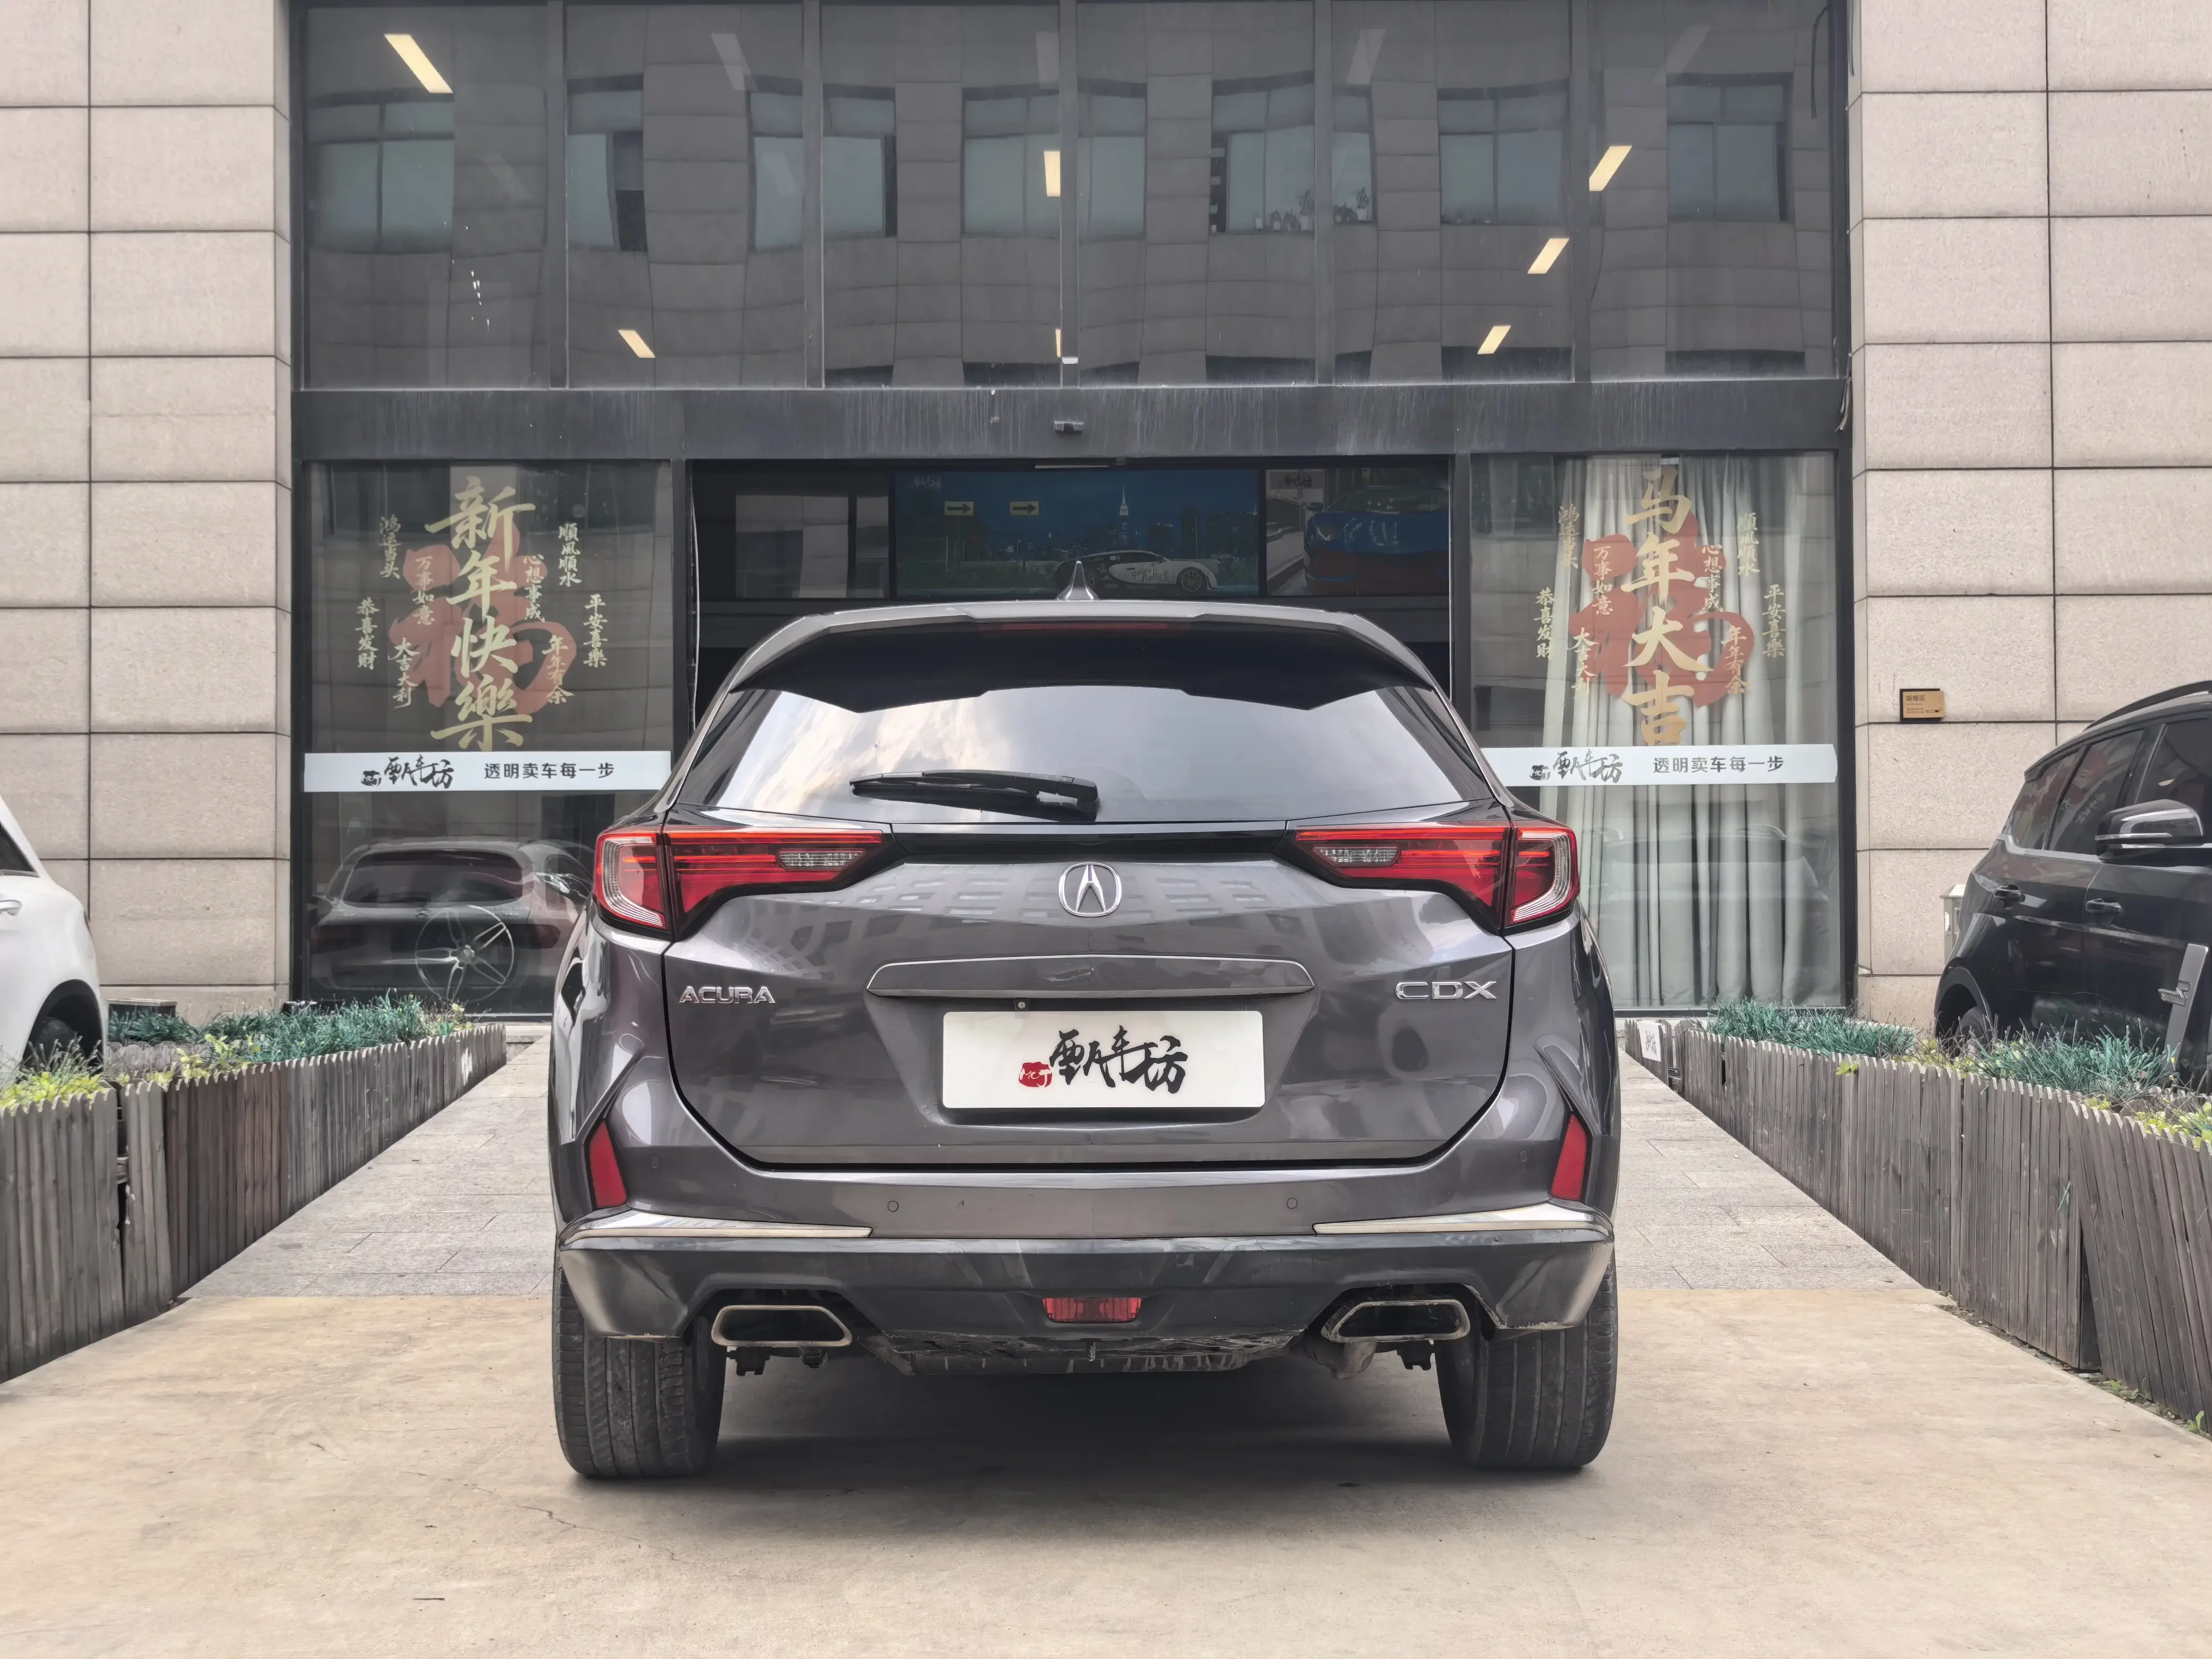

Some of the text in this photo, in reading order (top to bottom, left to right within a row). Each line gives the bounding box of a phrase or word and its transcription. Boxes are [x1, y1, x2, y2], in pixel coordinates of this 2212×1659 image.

[412, 556, 435, 625] 万事如意
[523, 554, 545, 623] 心想事成
[1592, 545, 1614, 615] 万事如意
[1621, 467, 1713, 746] 马年大吉
[1702, 545, 1723, 612] 心想事成
[387, 637, 421, 710] 大吉大利
[542, 634, 576, 704] 年年有余
[1721, 625, 1750, 694] 年年有余
[484, 762, 615, 779] 透明卖车每一步
[1654, 755, 1784, 773] 透明卖车每一步
[679, 985, 775, 1004] ACURA
[1395, 981, 1497, 1000] CDX
